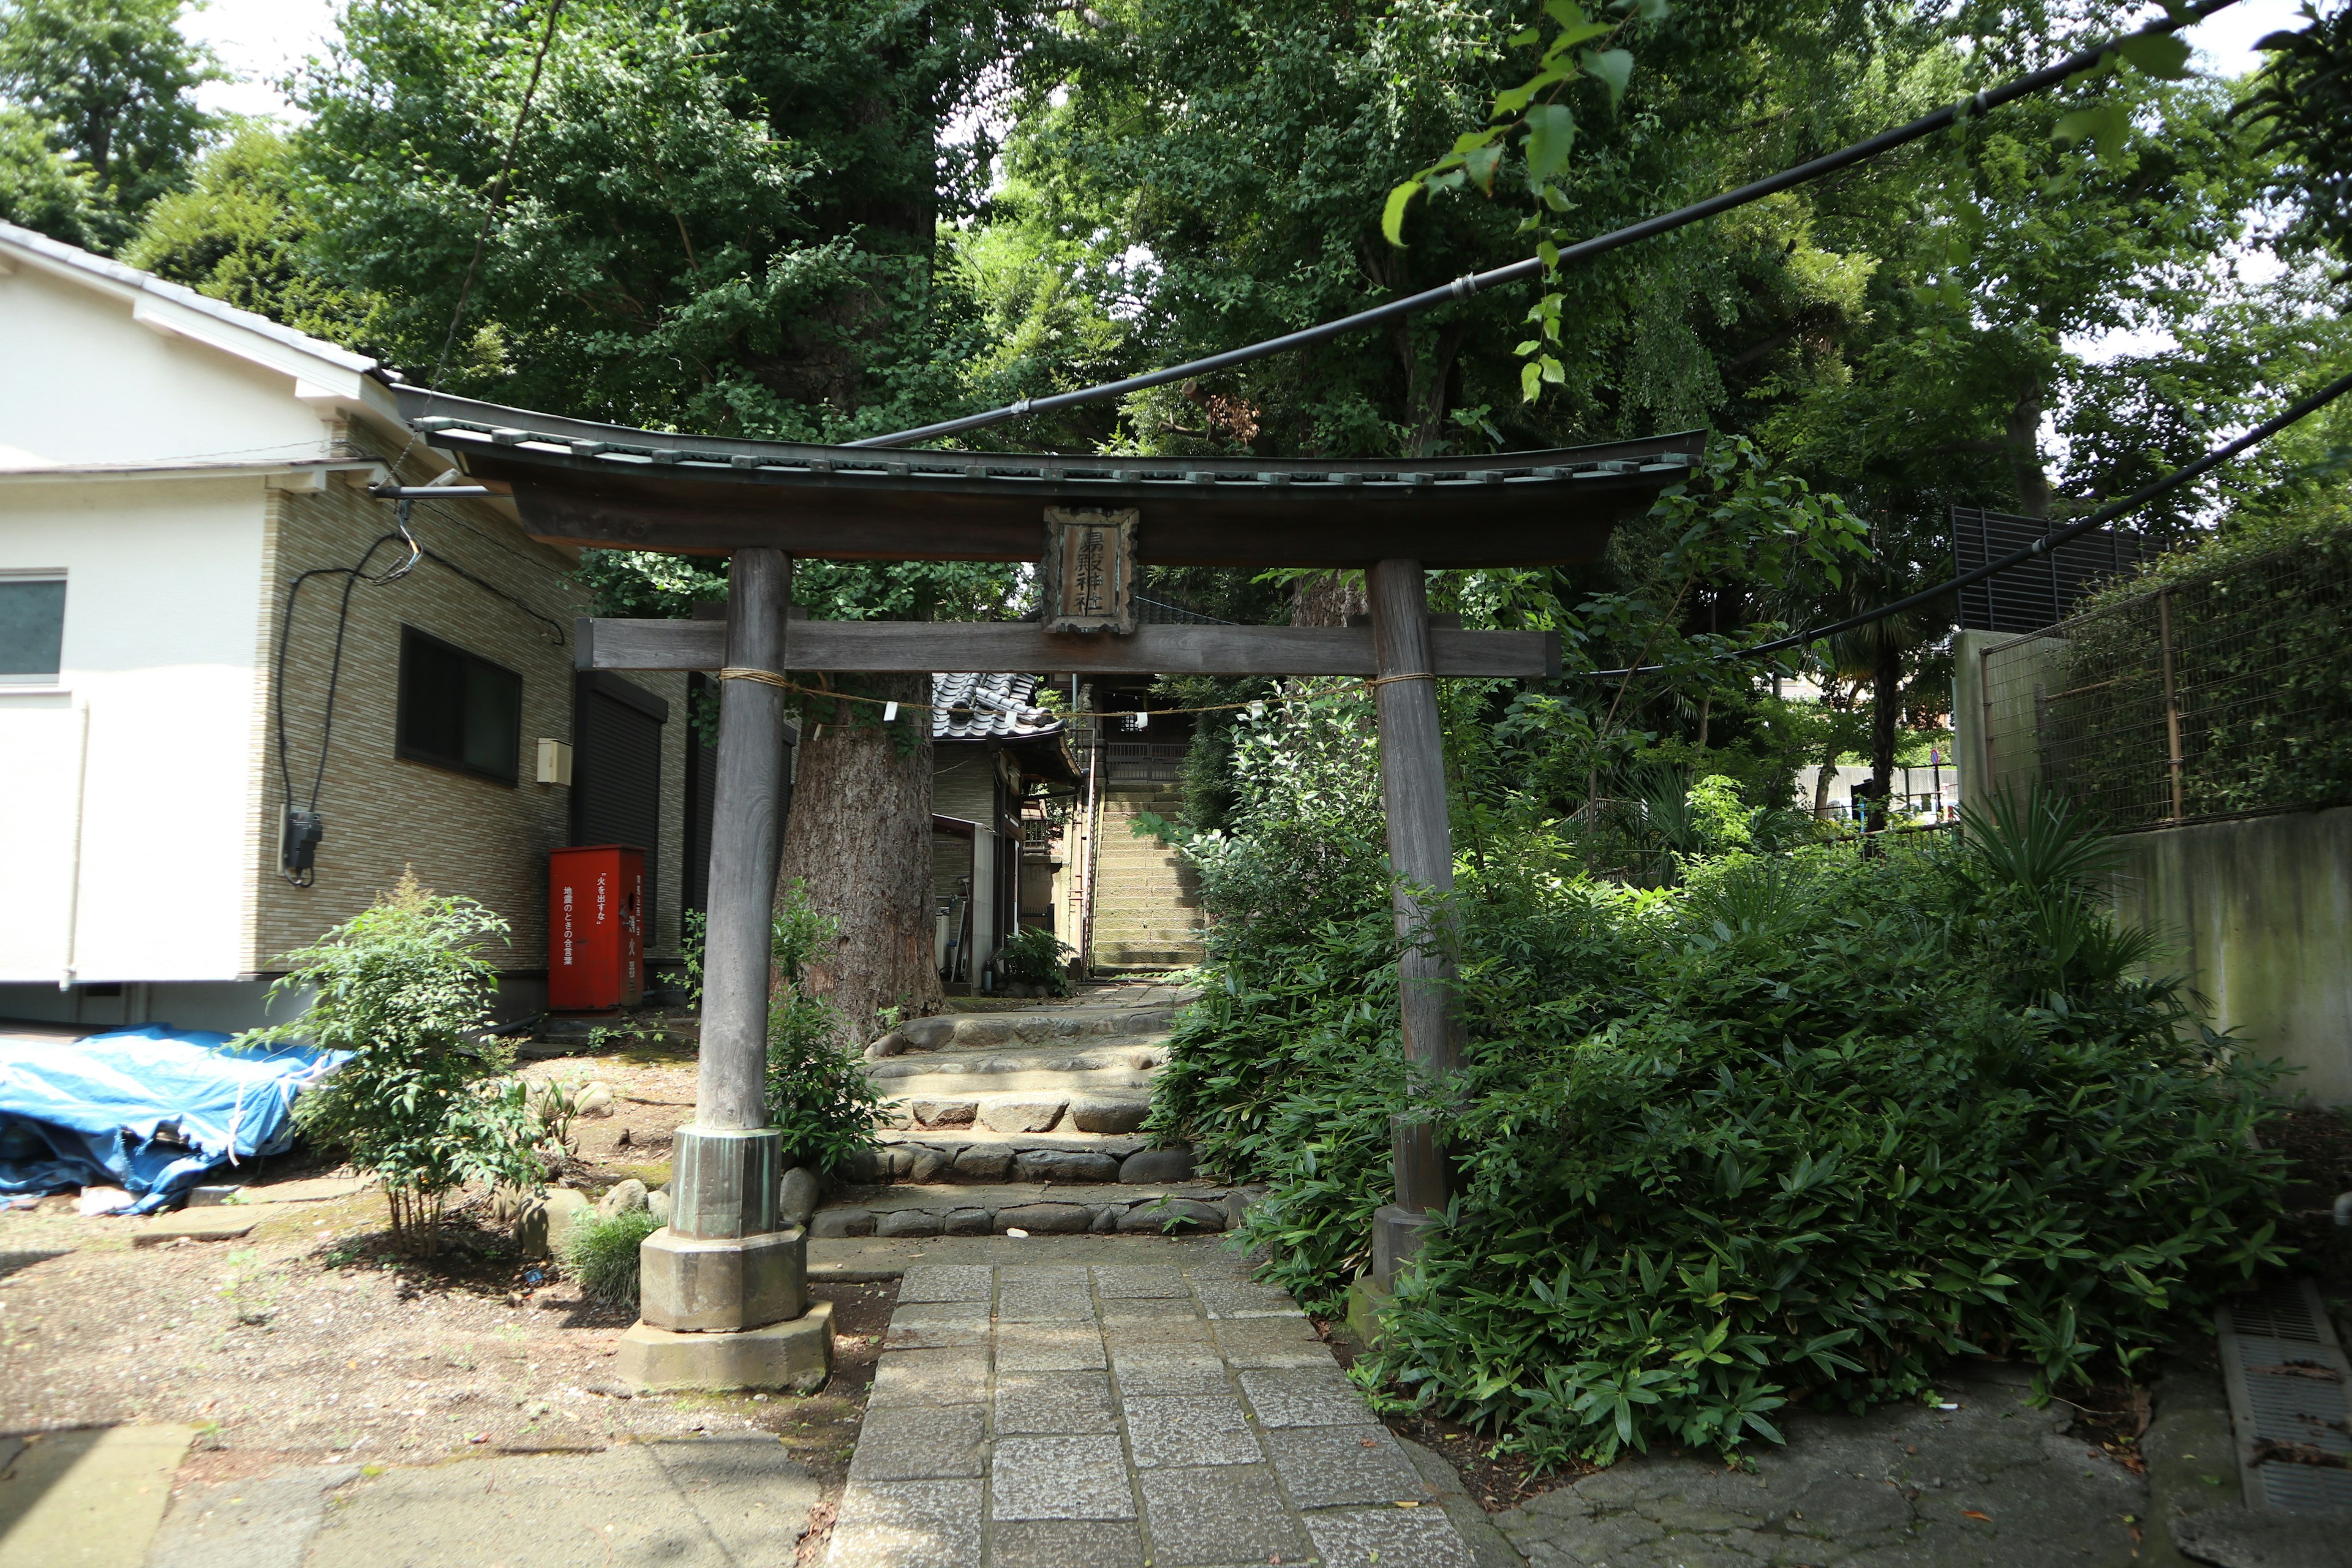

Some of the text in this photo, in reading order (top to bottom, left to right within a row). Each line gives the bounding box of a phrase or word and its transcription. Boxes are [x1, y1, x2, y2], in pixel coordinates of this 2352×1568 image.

[564, 887, 573, 965] 地震のときの合言葉
